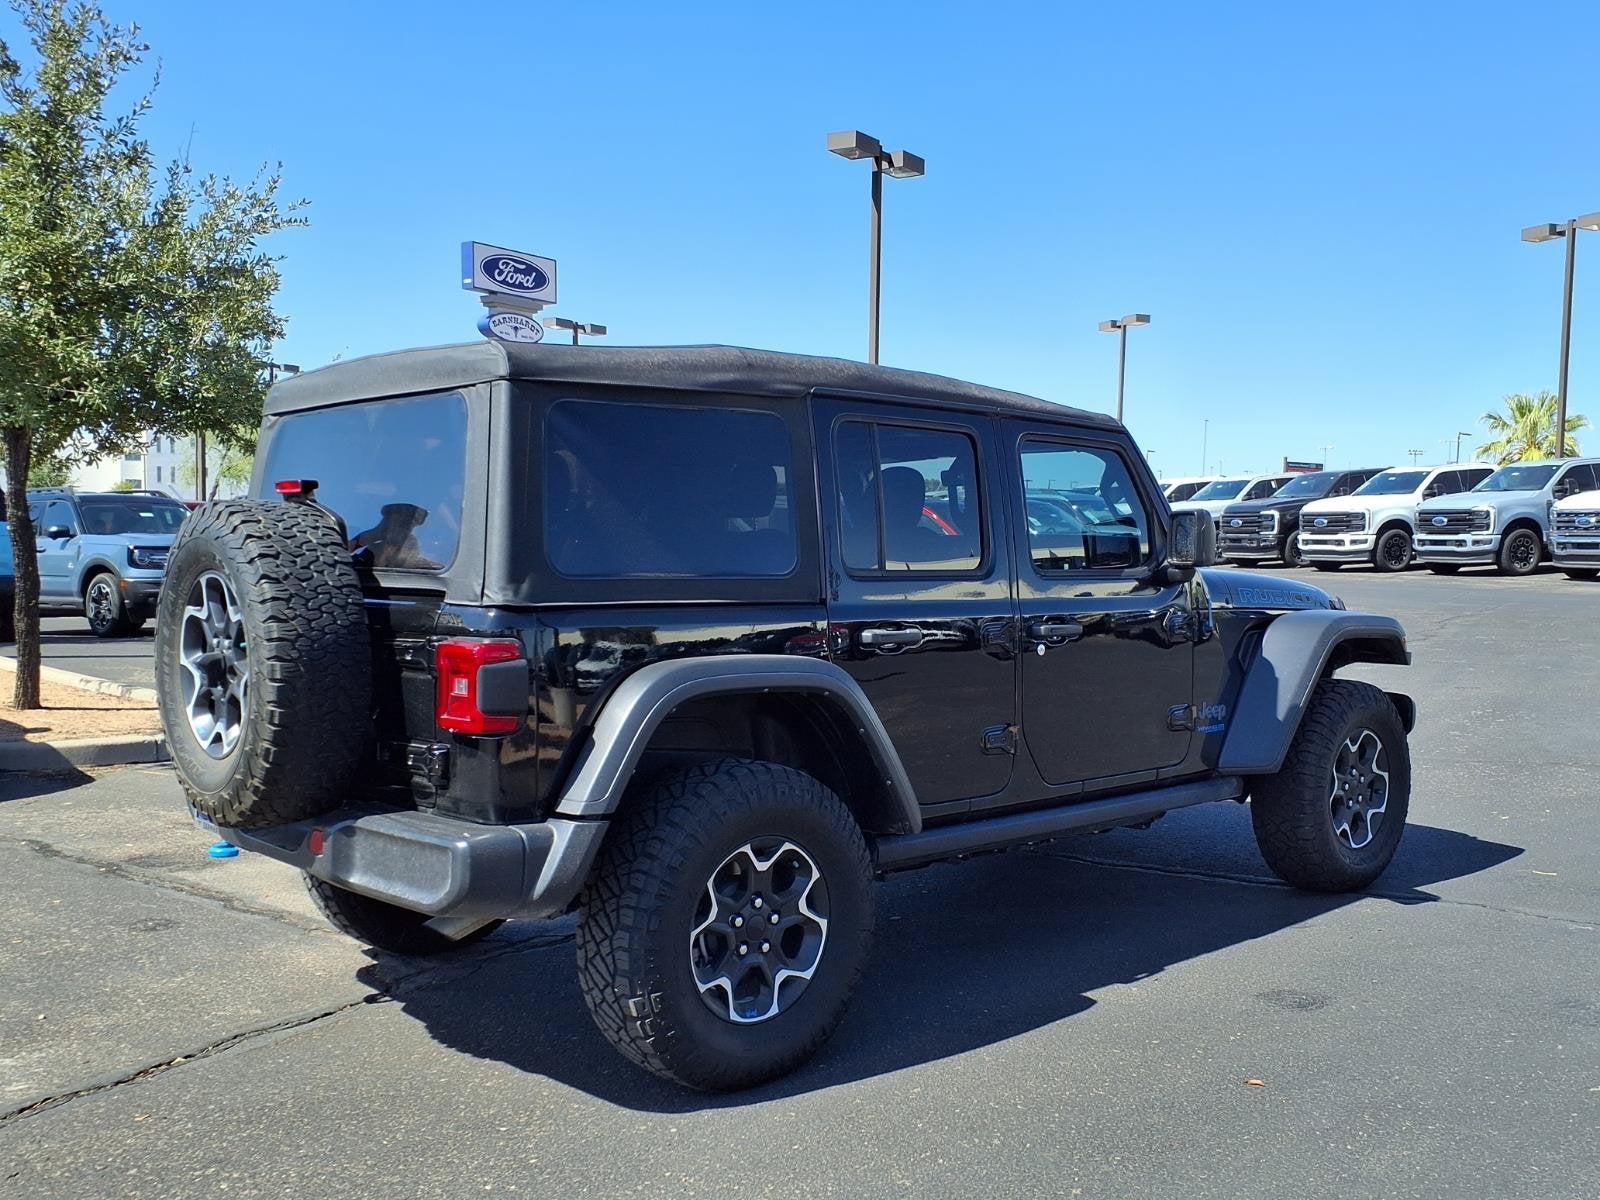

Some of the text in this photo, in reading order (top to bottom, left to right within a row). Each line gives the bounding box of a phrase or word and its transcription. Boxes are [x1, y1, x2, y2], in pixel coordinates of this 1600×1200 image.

[495, 259, 536, 288] Ford
[492, 316, 540, 335] EARNHARDT
[1239, 588, 1321, 604] RUBICO
[1200, 701, 1226, 720] Jeep
